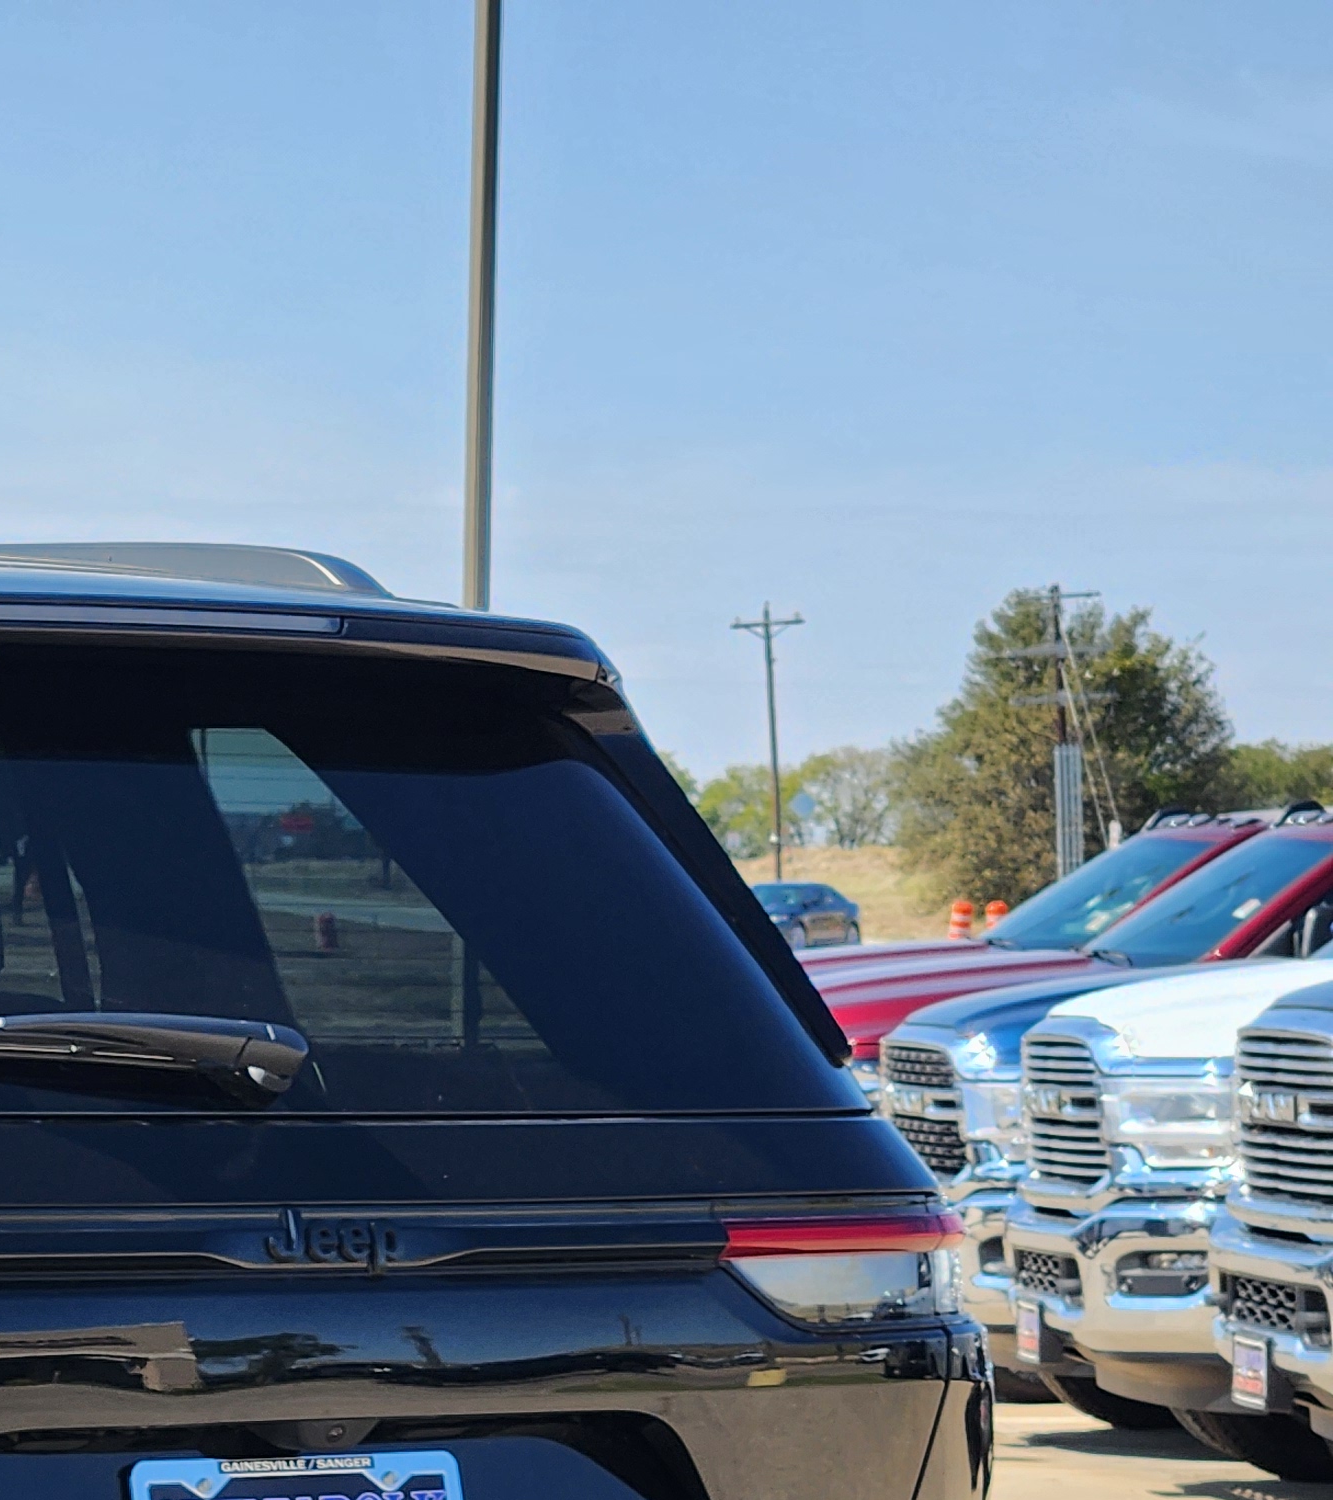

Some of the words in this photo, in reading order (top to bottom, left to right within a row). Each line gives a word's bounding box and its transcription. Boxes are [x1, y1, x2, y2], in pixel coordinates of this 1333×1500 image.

[263, 1207, 400, 1276] Jeep
[220, 1459, 307, 1473] GAINESVILLE
[316, 1457, 372, 1470] SANGER
